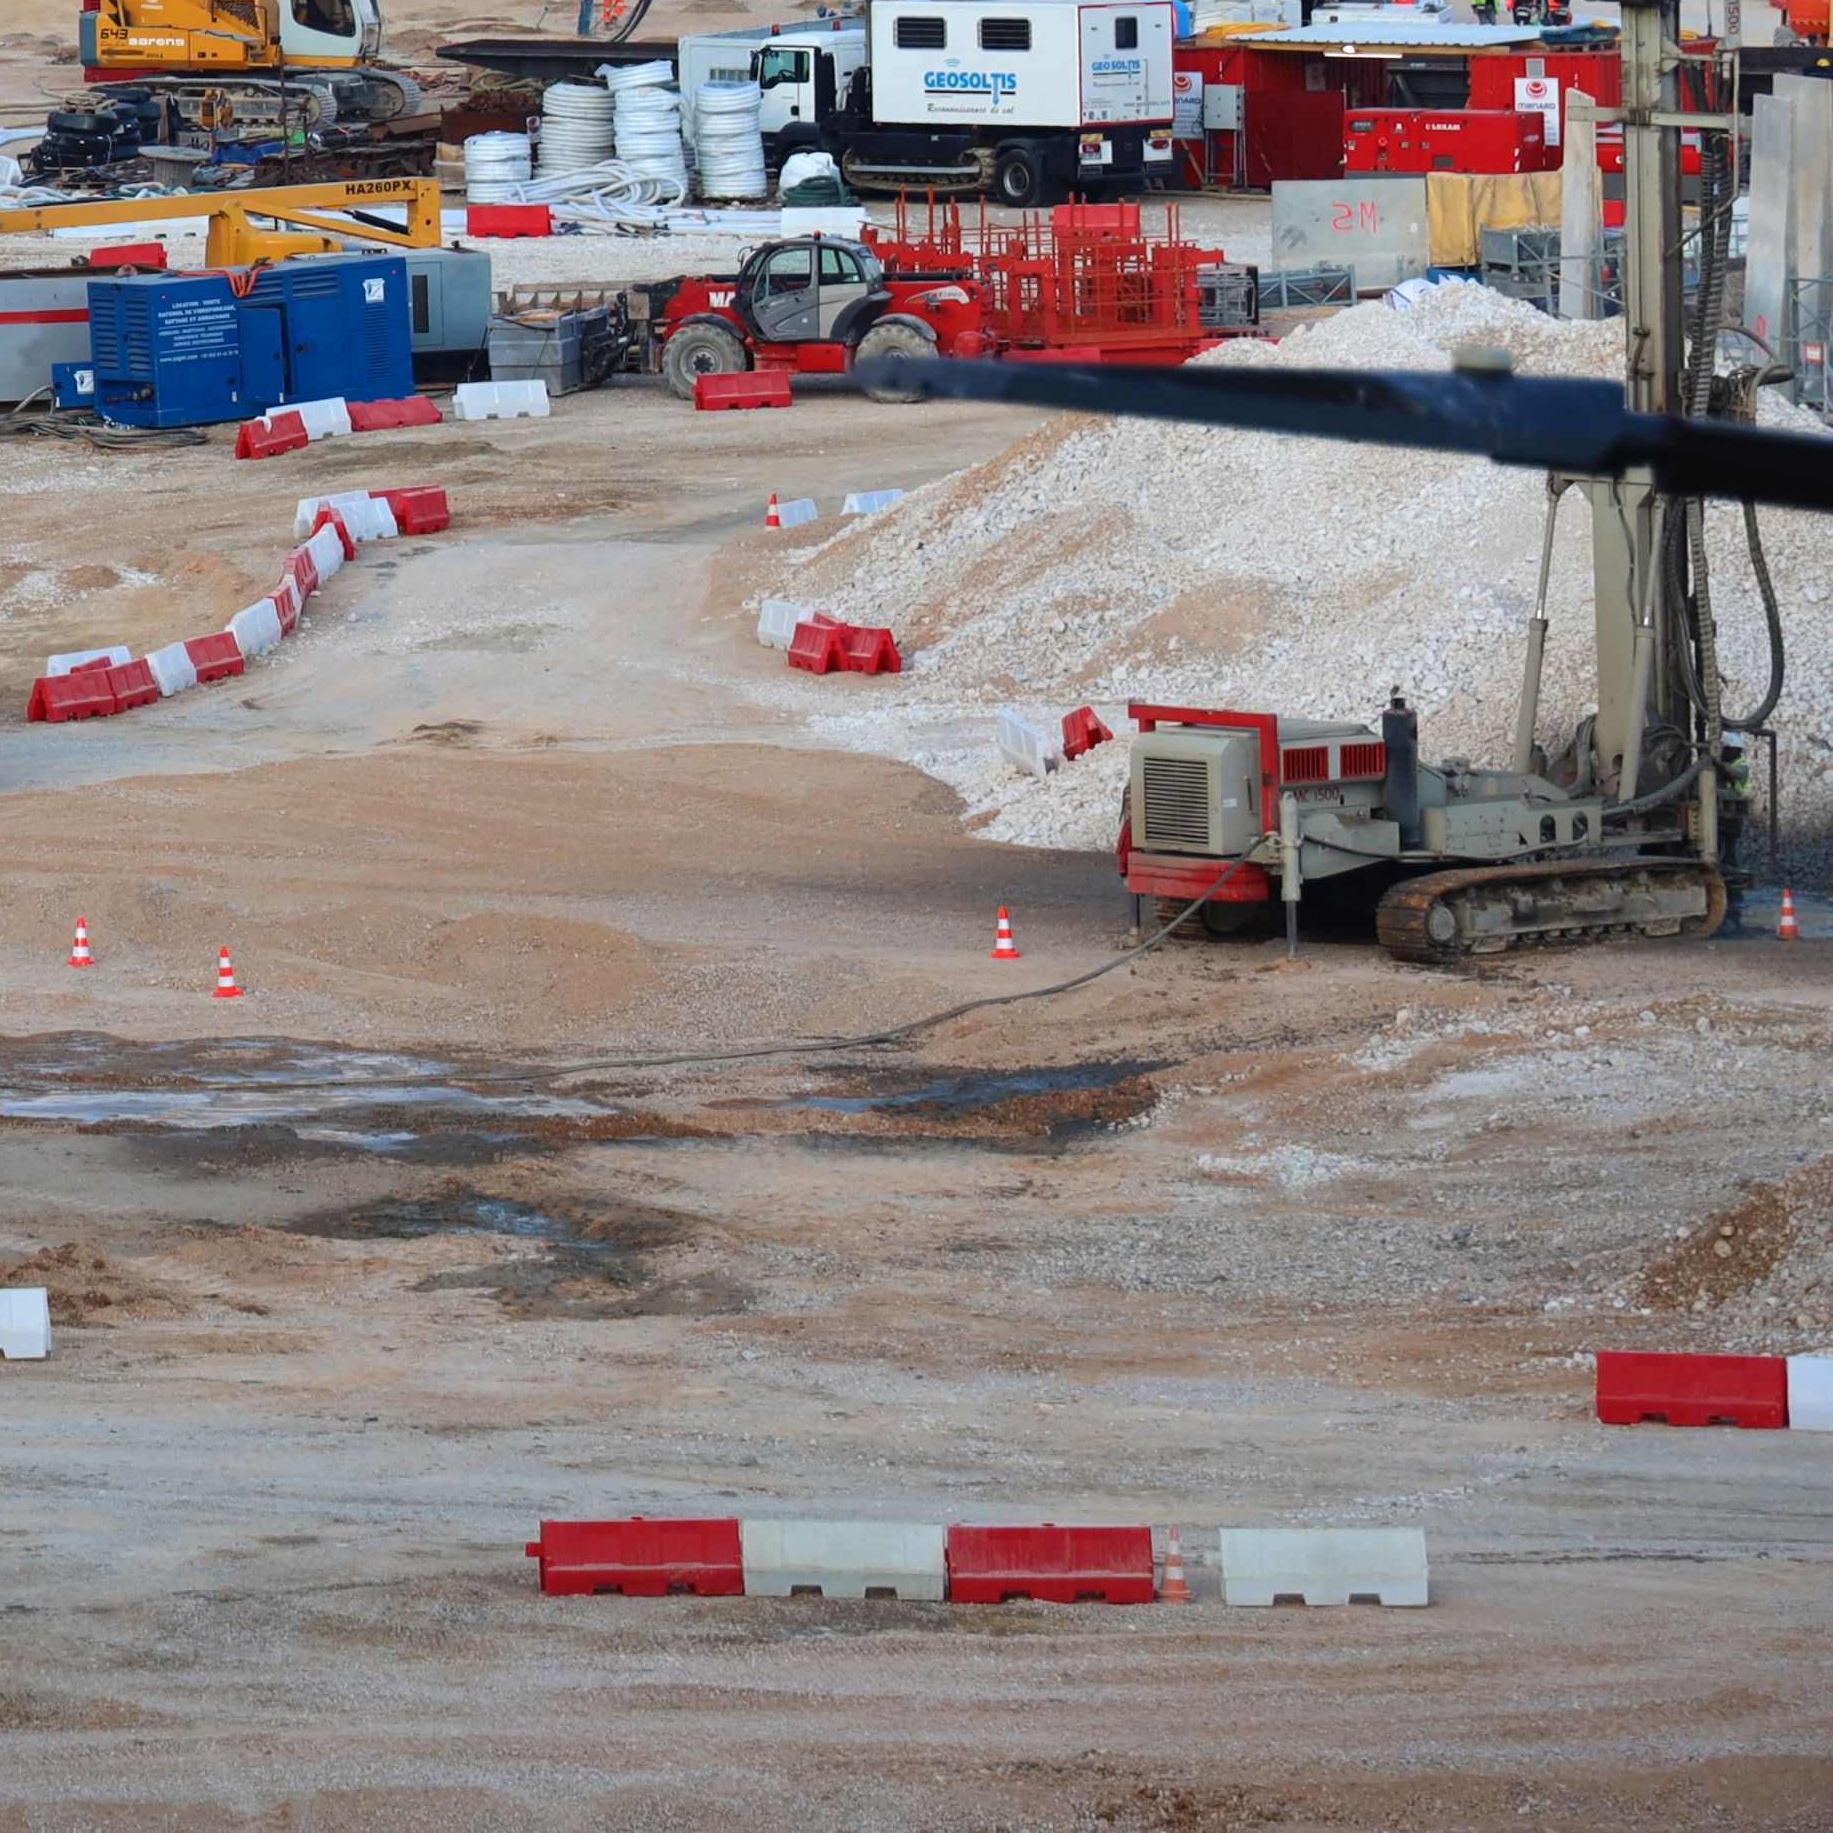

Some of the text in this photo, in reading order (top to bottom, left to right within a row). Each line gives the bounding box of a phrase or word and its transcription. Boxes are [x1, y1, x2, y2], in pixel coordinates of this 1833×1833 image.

[1726, 0, 1740, 36] 1500
[100, 28, 129, 40] 643
[128, 37, 185, 46] sarens
[924, 71, 1017, 96] GEOSOLTIS
[345, 179, 412, 195] HA260PX
